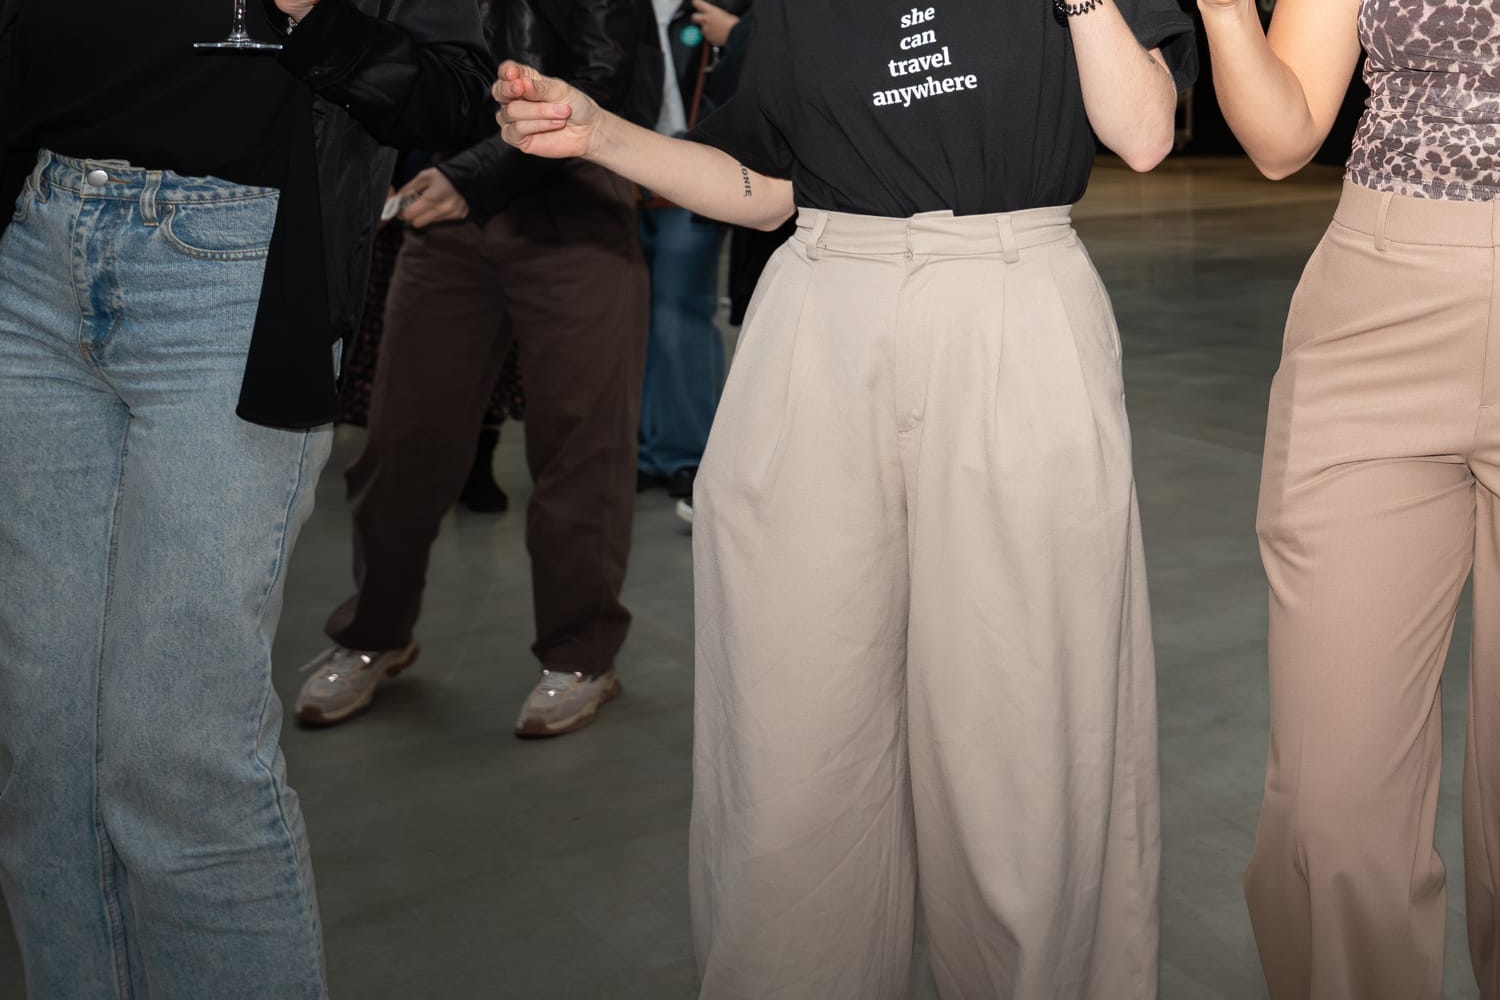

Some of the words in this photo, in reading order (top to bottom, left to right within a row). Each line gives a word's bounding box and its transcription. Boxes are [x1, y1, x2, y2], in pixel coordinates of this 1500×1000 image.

[900, 7, 935, 28] she
[900, 29, 937, 50] can
[888, 46, 951, 77] travel
[872, 74, 978, 107] anywhere
